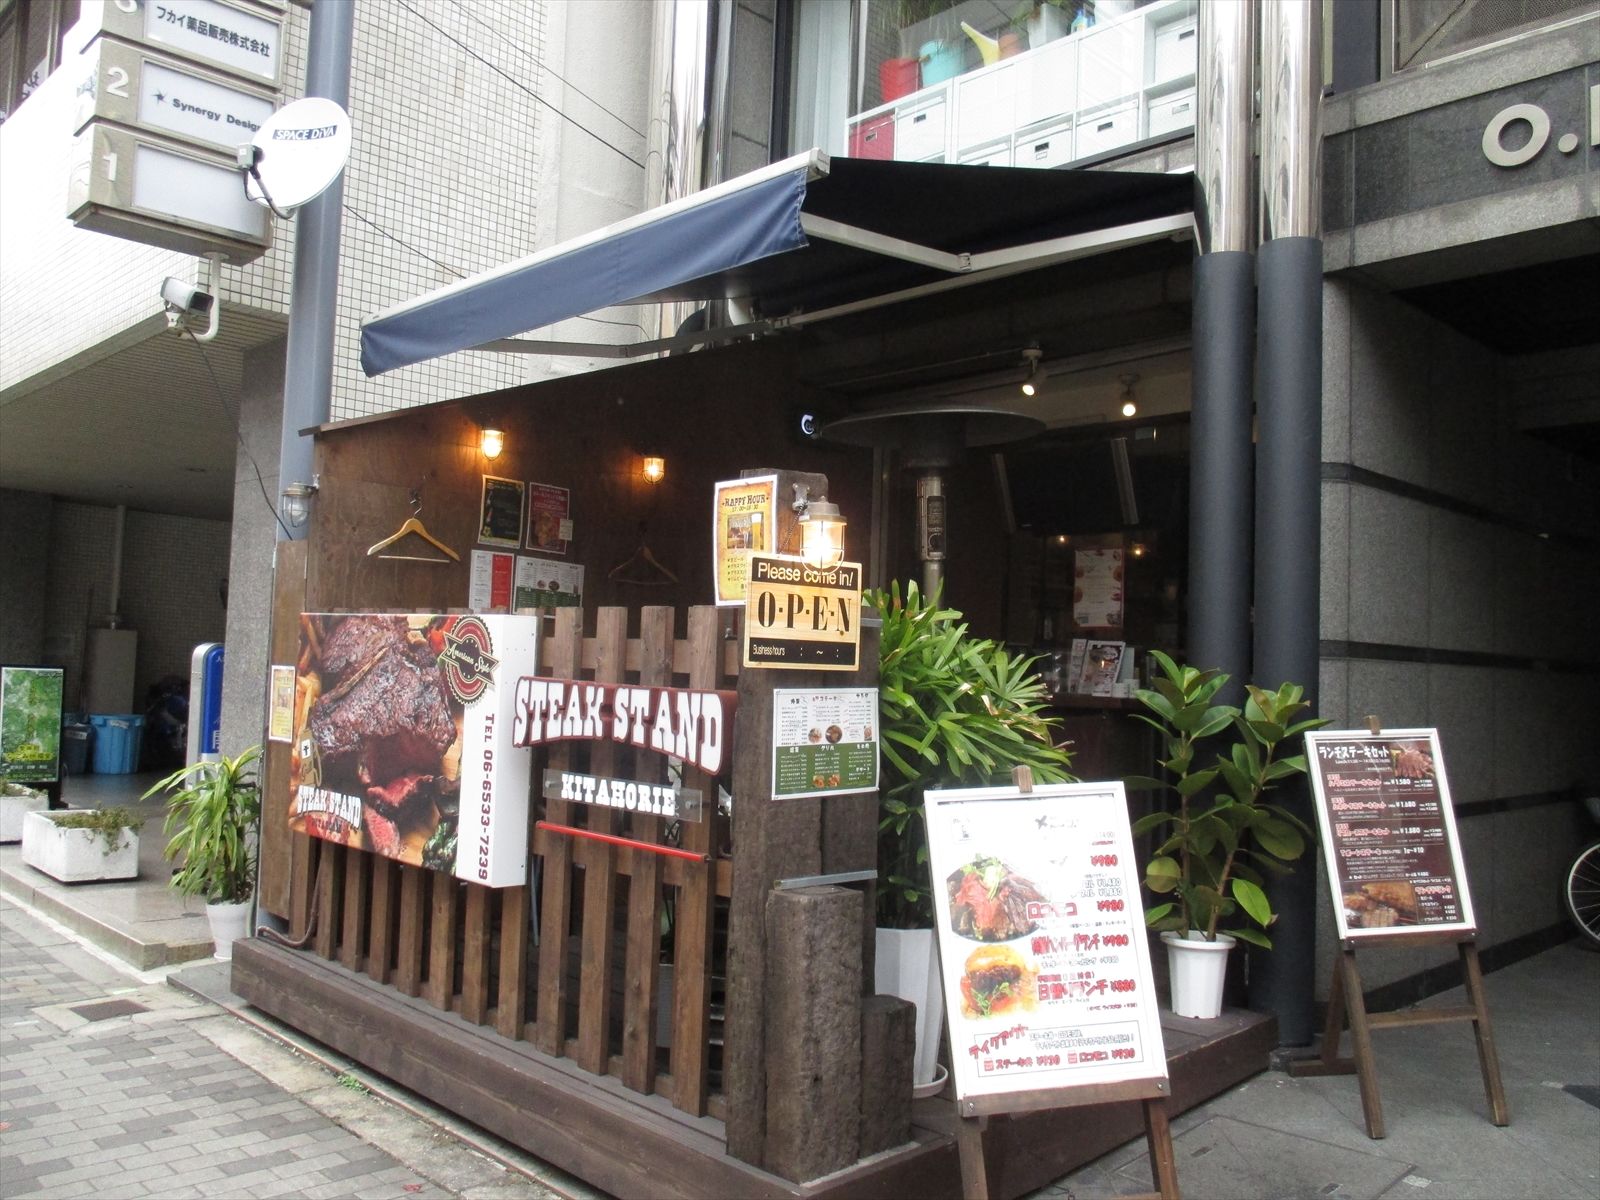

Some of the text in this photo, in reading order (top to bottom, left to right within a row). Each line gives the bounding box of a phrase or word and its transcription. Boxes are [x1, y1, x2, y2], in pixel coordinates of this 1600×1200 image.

[156, 5, 270, 58] フカイ薬品販売株式会社
[106, 66, 129, 98] 2
[172, 98, 221, 121] Synergy
[274, 128, 309, 140] SPACE
[103, 152, 118, 182] 1
[724, 494, 766, 507] HAPPY HOUR
[758, 562, 801, 582] Please
[803, 570, 837, 586] come
[839, 570, 854, 587] in!
[753, 643, 786, 656] Business hours
[513, 677, 605, 748] STEAK
[612, 687, 723, 775] STAND
[1318, 744, 1390, 760] ランチステーキセット
[297, 784, 327, 815] STEAK
[328, 790, 362, 830] STAND
[478, 713, 495, 881] TEL 06-6533-7239
[561, 773, 677, 817] KITAHORIE
[1027, 902, 1078, 920] ロココ
